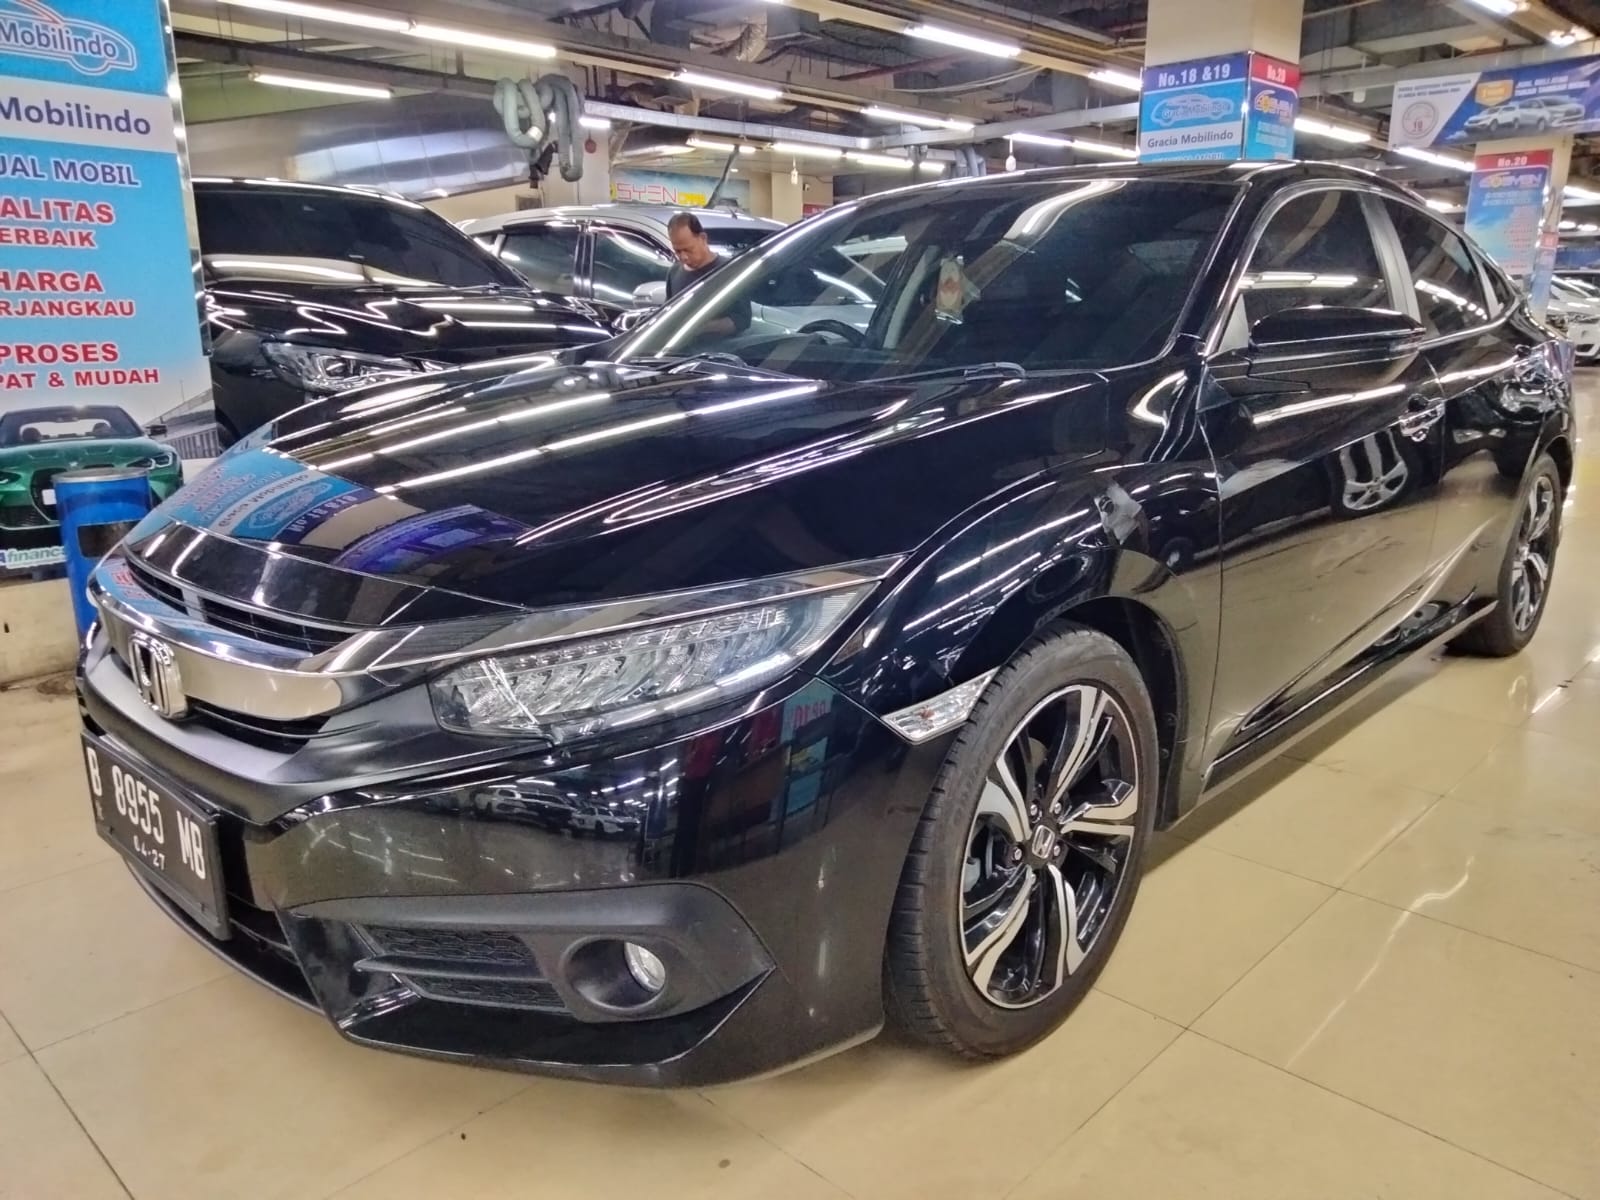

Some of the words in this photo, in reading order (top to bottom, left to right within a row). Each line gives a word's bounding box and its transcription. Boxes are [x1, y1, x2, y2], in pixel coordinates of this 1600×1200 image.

[1147, 135, 1178, 148] Gracia
[1181, 130, 1233, 145] Mobilindo
[53, 161, 139, 186] MOBIL
[49, 372, 65, 387] &
[76, 369, 159, 386] MUDAH
[8, 547, 66, 562] financ
[86, 746, 103, 797] B
[112, 765, 165, 844] 8955
[176, 810, 206, 880] MB
